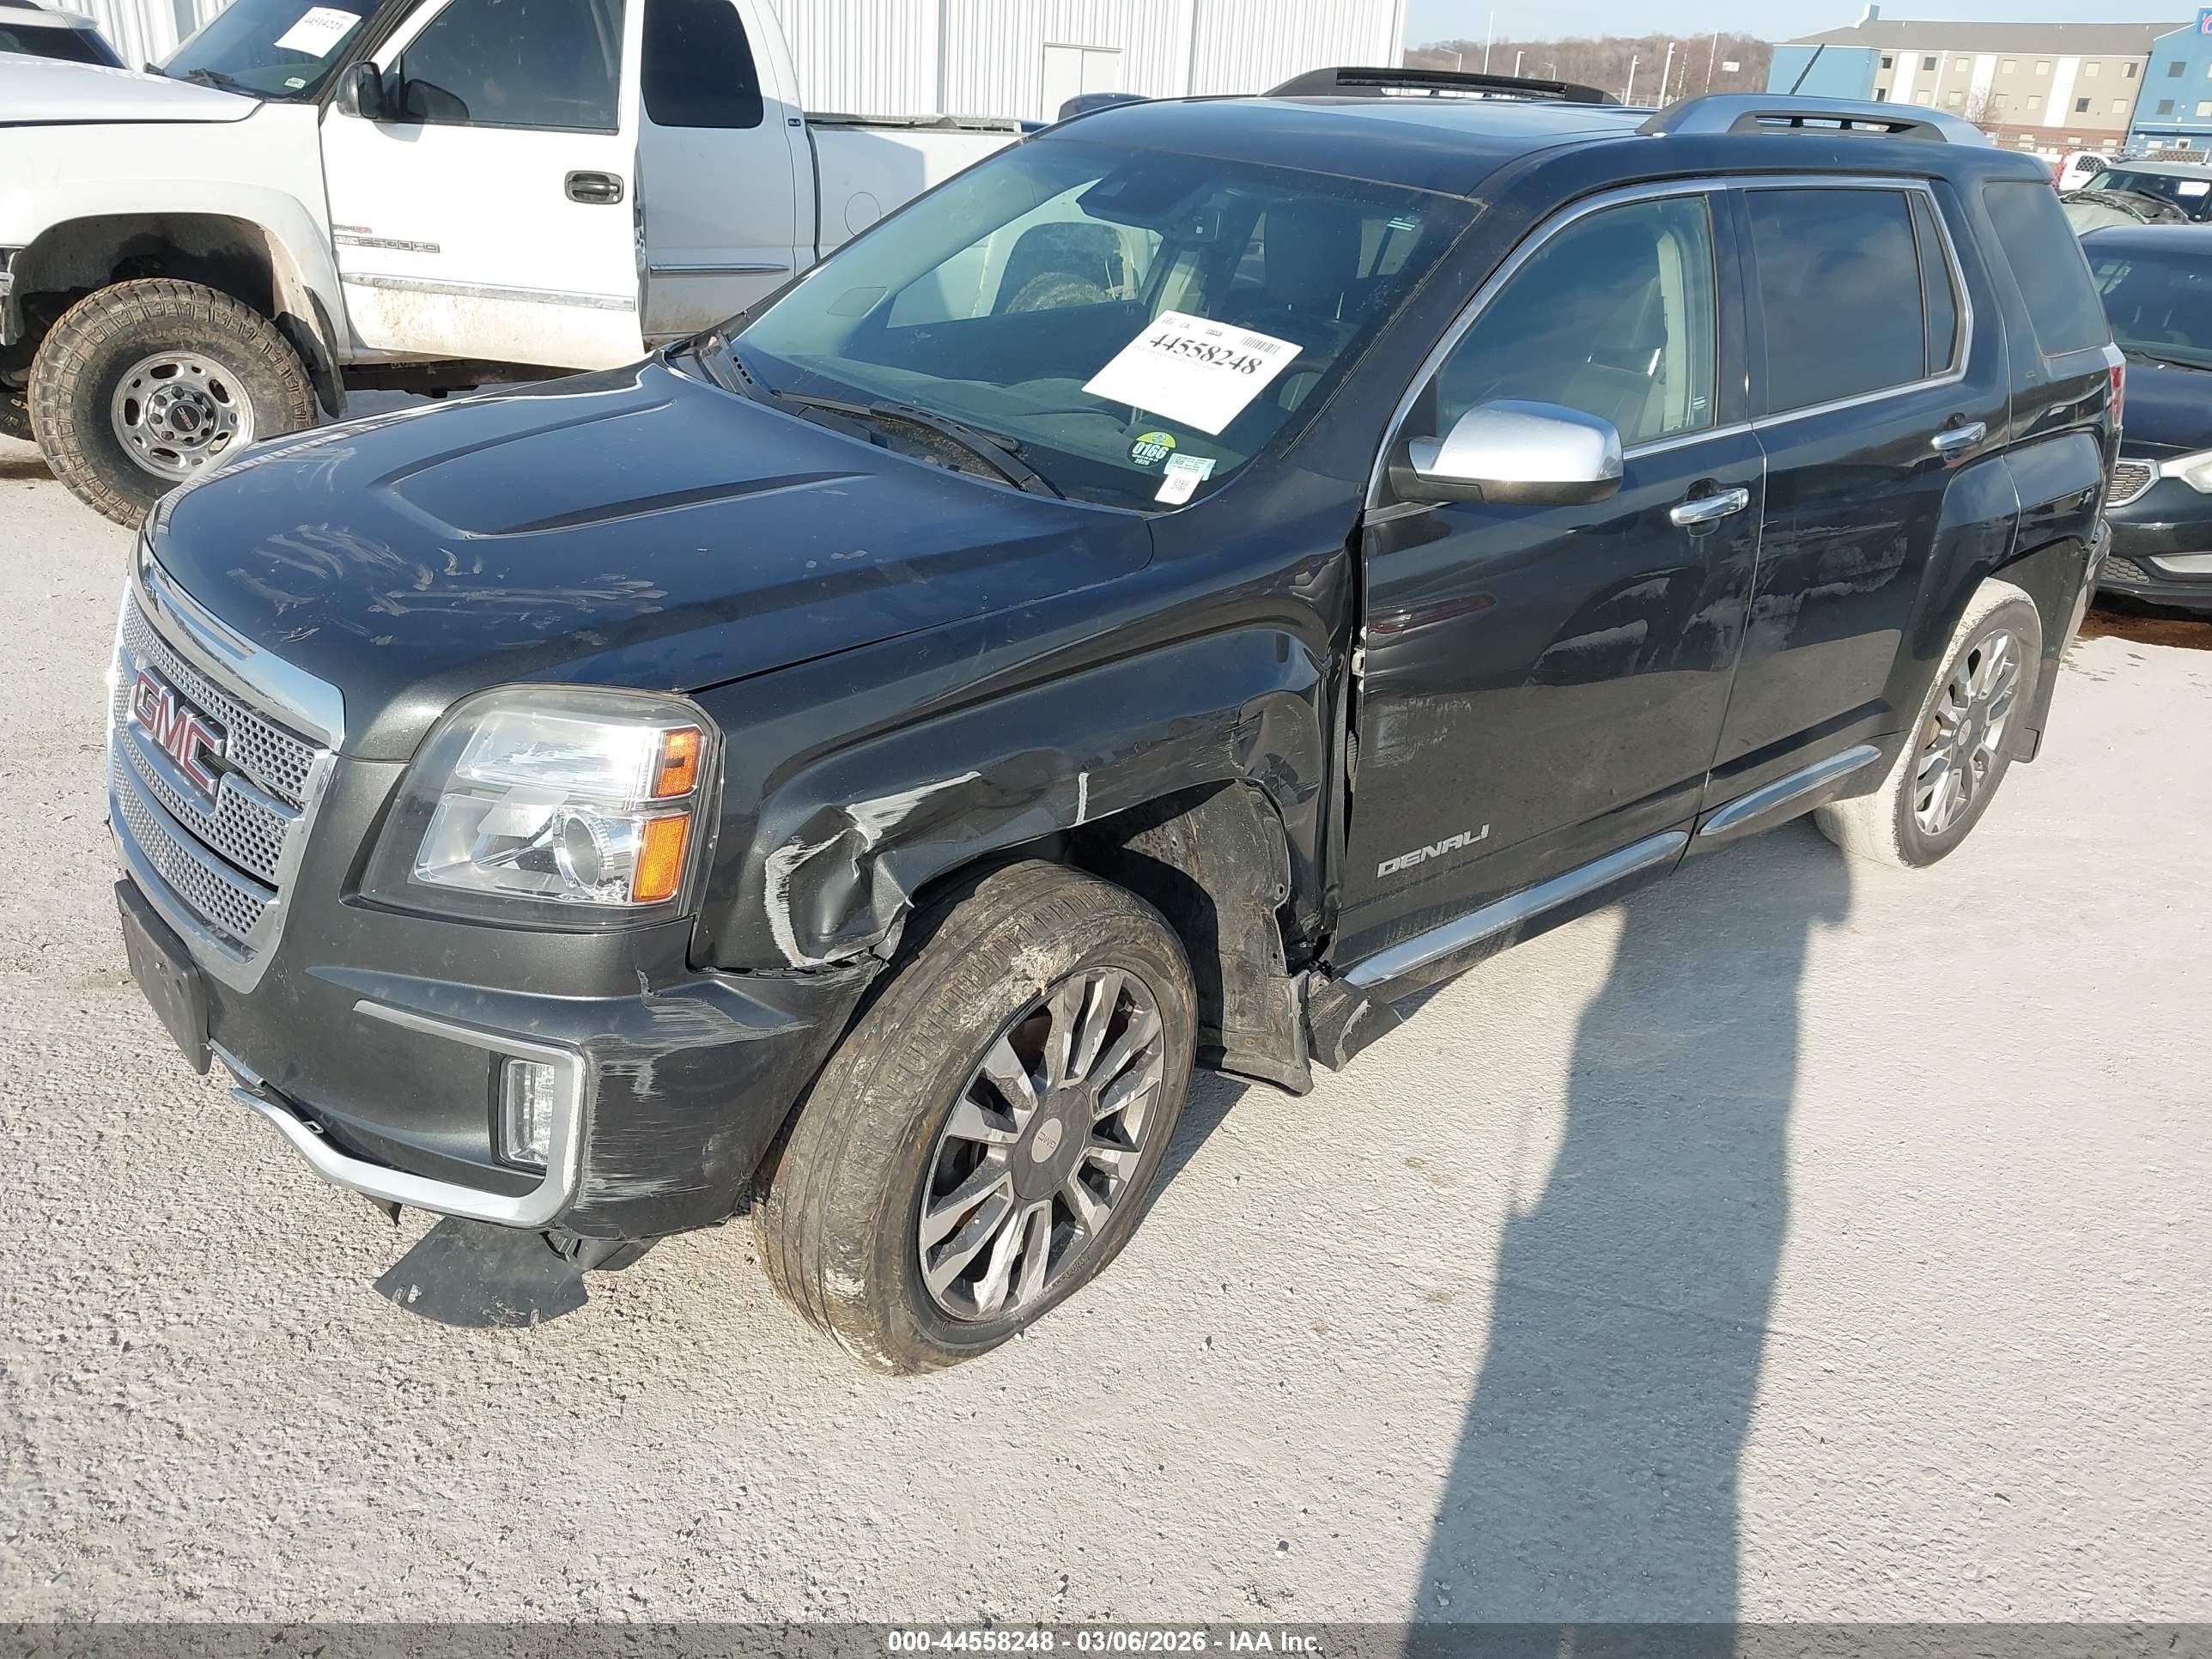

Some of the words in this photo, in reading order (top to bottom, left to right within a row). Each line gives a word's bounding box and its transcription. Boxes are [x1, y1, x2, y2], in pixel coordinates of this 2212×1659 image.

[1150, 333, 1263, 374] 44558248
[1132, 441, 1170, 459] 0166
[134, 670, 222, 795] GMC
[1376, 823, 1490, 878] DENALI
[1037, 1131, 1057, 1149] GMC
